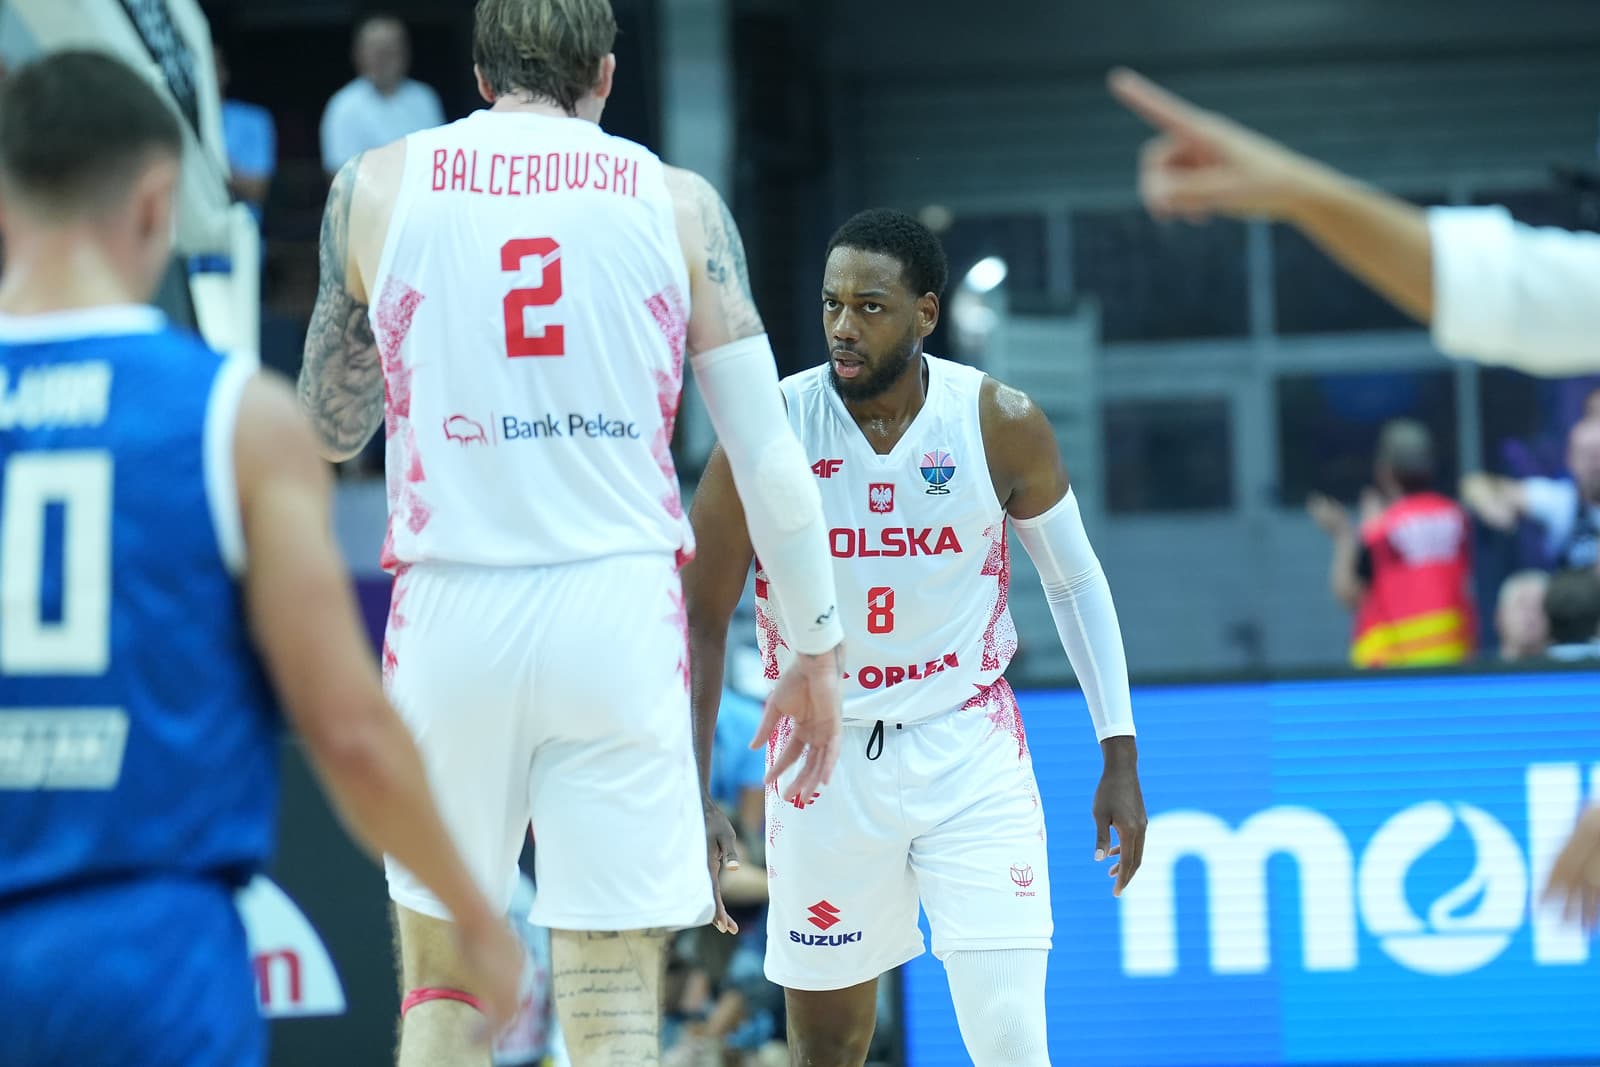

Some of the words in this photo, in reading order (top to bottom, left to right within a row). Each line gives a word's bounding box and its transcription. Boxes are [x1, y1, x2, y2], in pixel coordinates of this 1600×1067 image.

[432, 148, 638, 197] BALCEROWSKI
[500, 237, 565, 357] 2
[502, 413, 562, 440] Bank
[810, 458, 844, 478] 4F
[828, 526, 963, 558] OLSKA
[867, 586, 895, 634] 8
[857, 651, 960, 689] ORLEN
[1119, 761, 1600, 978] mol
[789, 930, 862, 946] SUZUKI
